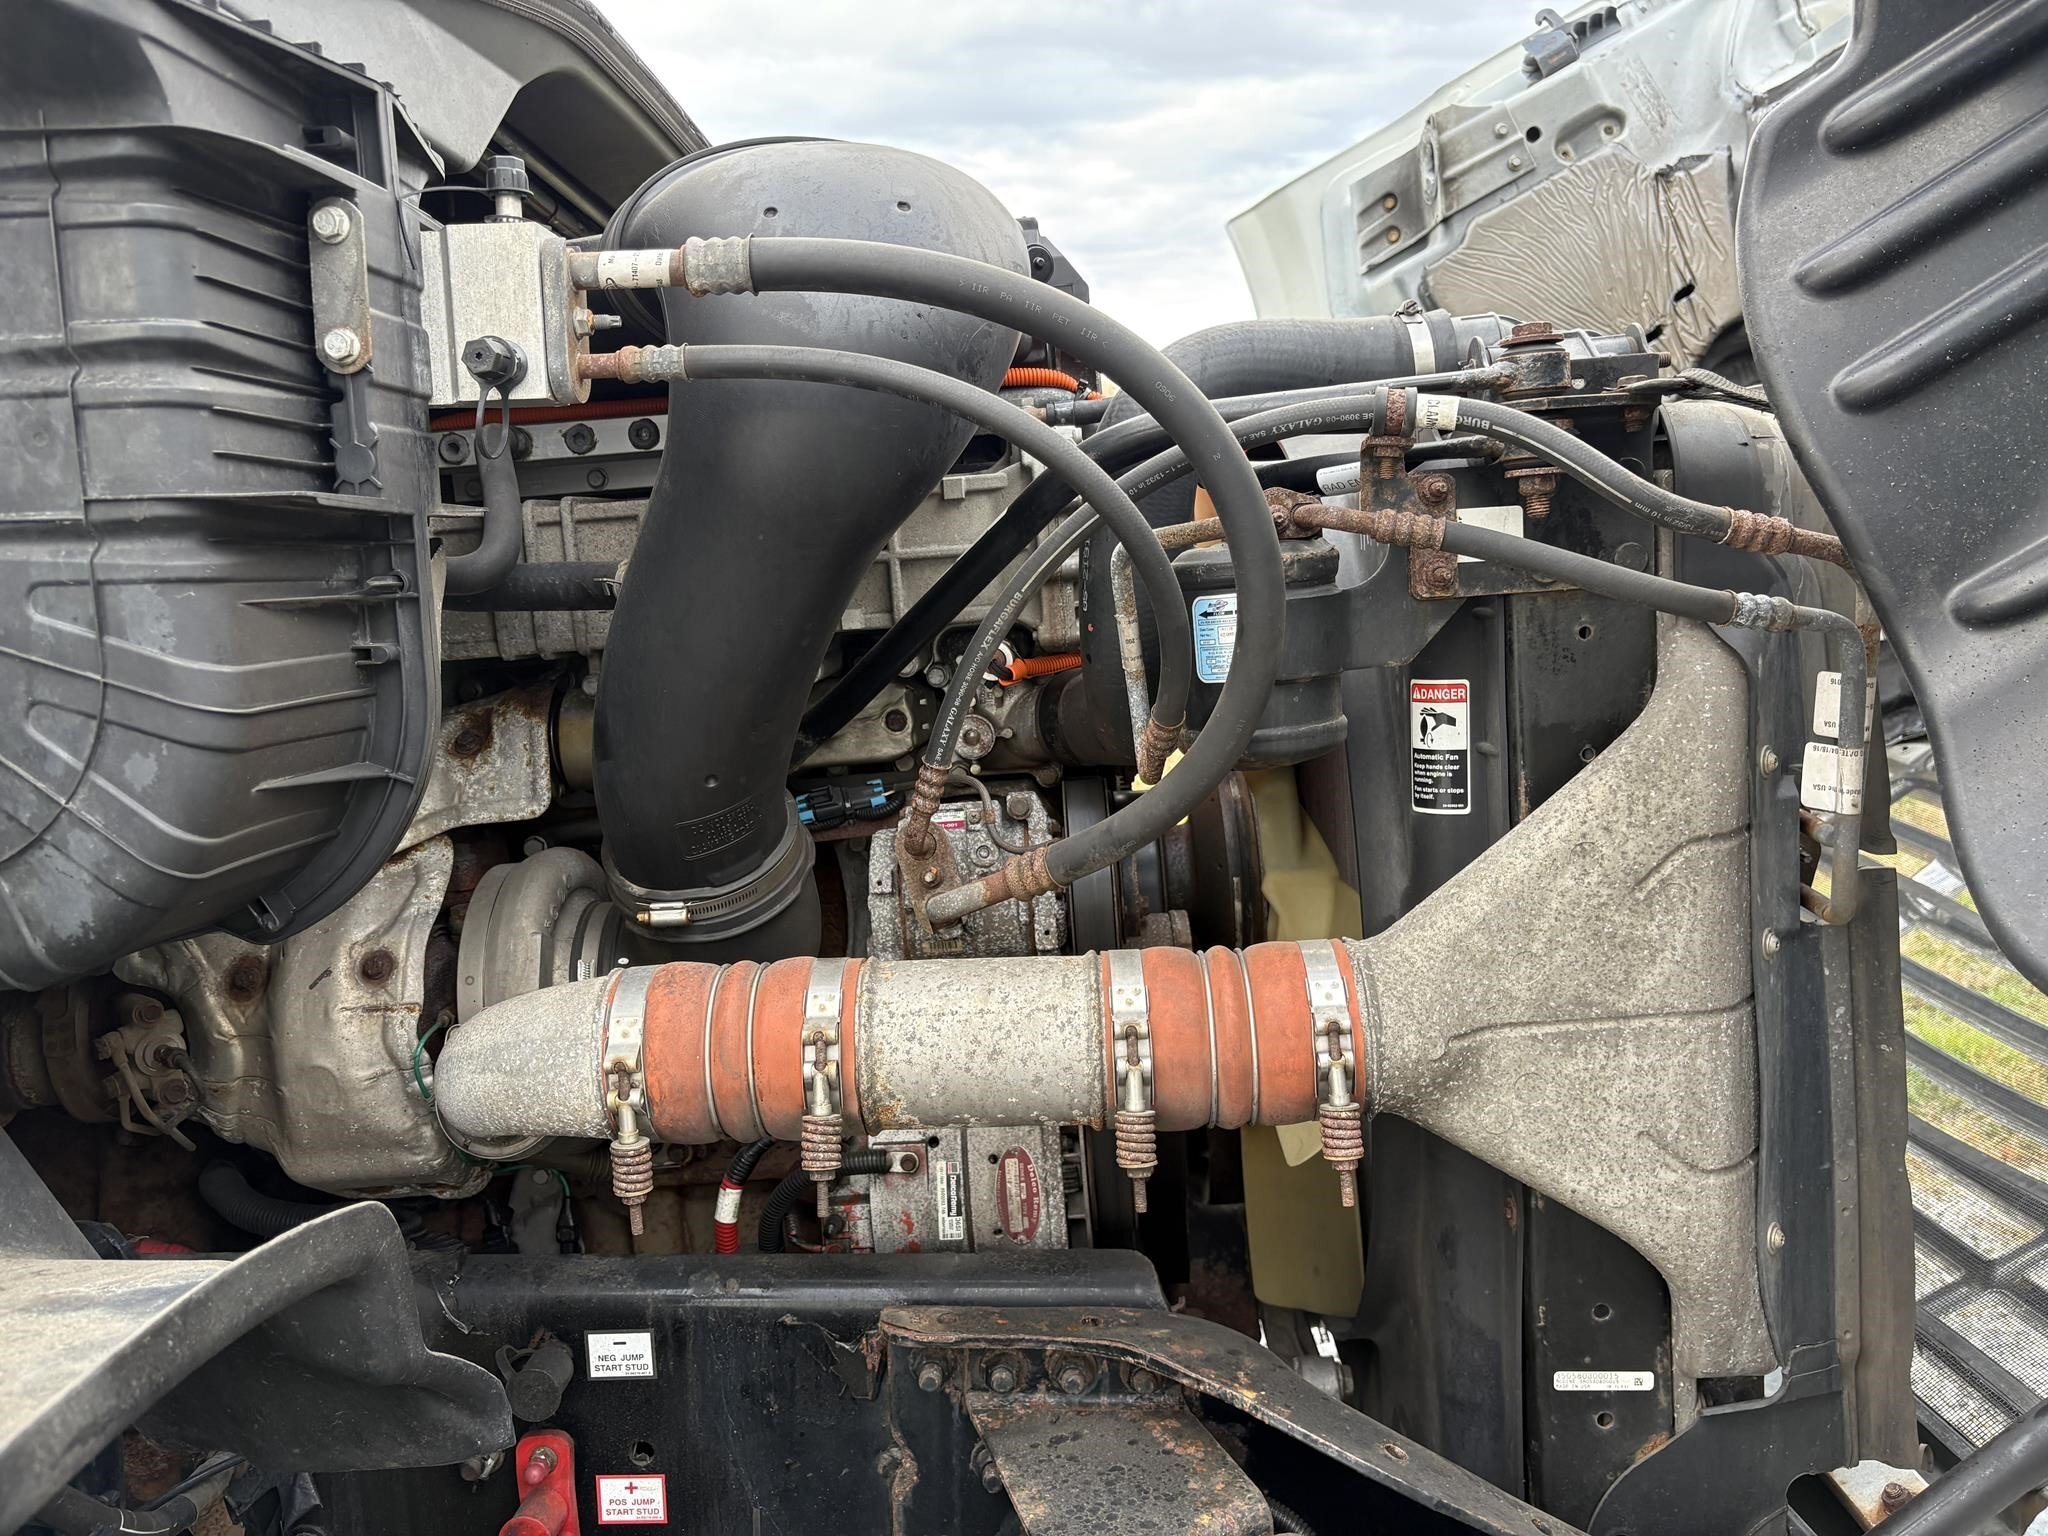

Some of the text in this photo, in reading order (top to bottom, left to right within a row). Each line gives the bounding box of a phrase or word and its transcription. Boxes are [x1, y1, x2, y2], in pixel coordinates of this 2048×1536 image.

[1270, 416, 1323, 435] GALAXY
[1322, 480, 1346, 493] RAD
[1635, 501, 1650, 513] mm
[980, 591, 1024, 653] BURGAFLEX
[965, 663, 978, 682] HOSE
[1421, 688, 1466, 700] DANGER
[939, 706, 958, 748] GALAXY
[1823, 720, 1837, 729] USA
[934, 747, 945, 762] SAE
[1414, 752, 1459, 761] Automatic Fan
[1426, 762, 1443, 770] hands
[1414, 777, 1434, 785] running.
[1414, 785, 1422, 793] Fan
[1447, 787, 1465, 795] stops
[1812, 782, 1827, 792] USA
[1414, 792, 1420, 800] by
[1027, 1163, 1038, 1194] Delco
[598, 1353, 644, 1362] NEG JUMP
[594, 1363, 649, 1372] START STUD
[609, 1498, 656, 1506] POS JUMP
[605, 1507, 660, 1516] START STUD
